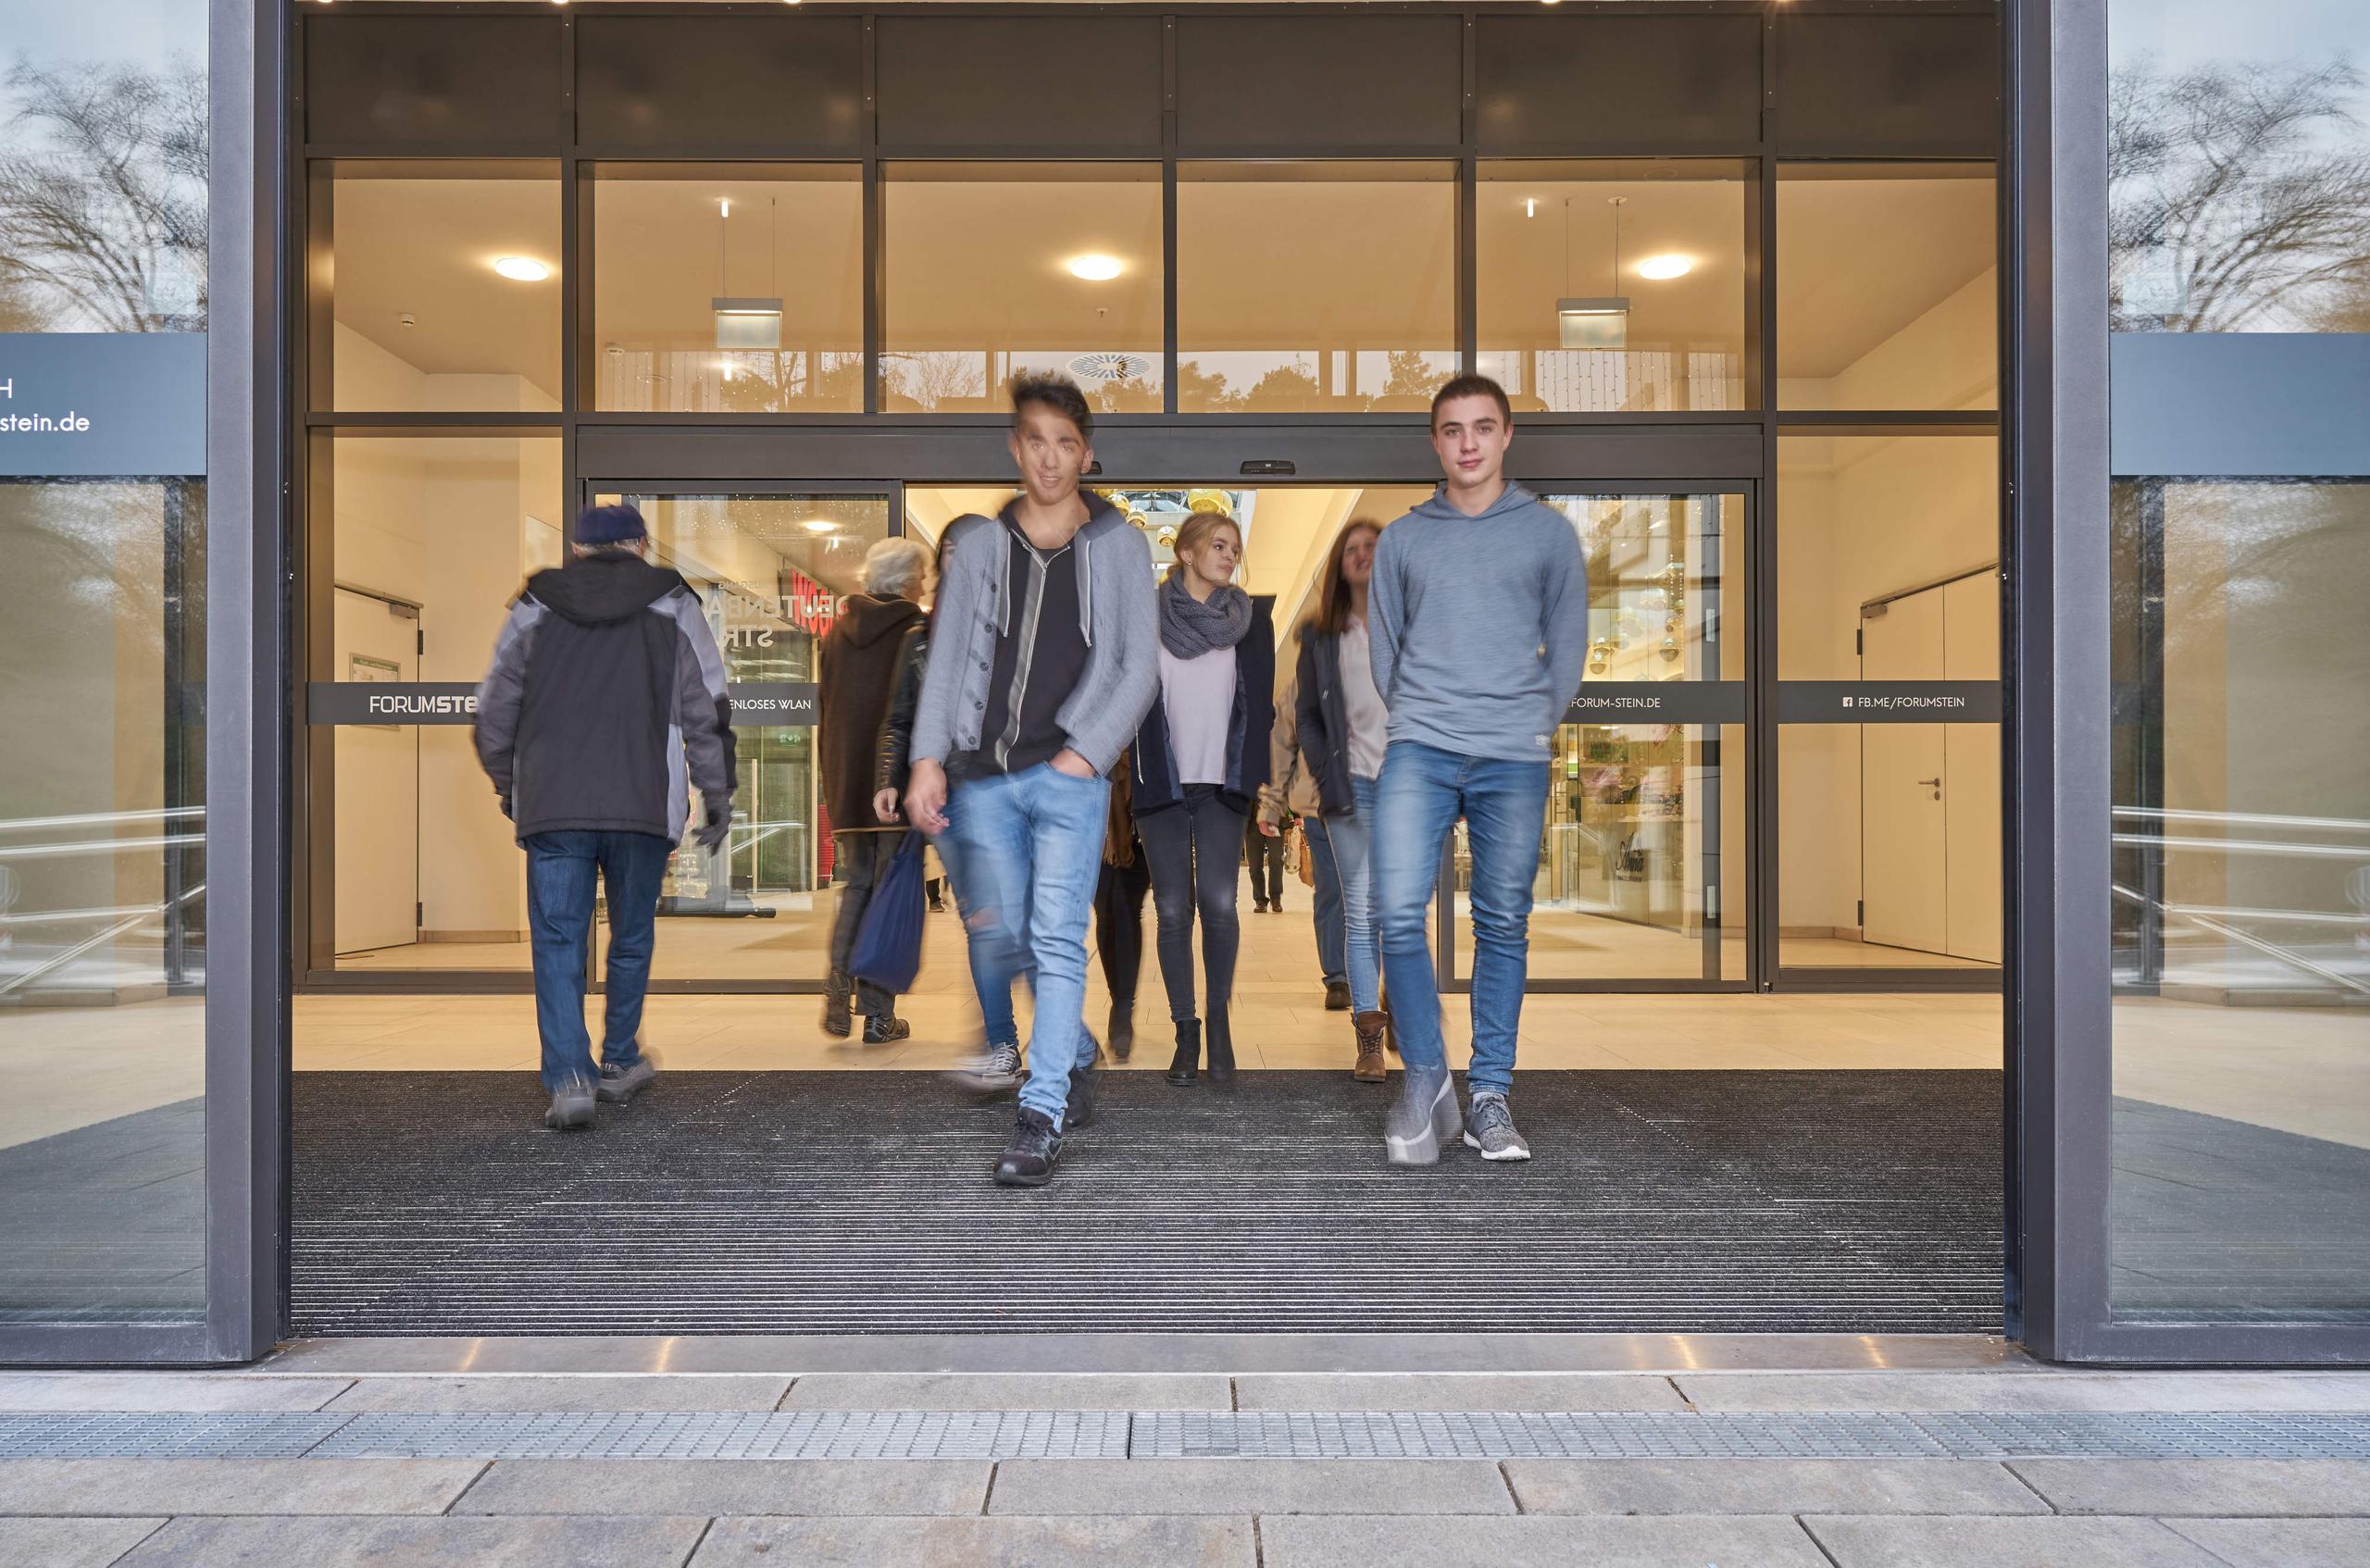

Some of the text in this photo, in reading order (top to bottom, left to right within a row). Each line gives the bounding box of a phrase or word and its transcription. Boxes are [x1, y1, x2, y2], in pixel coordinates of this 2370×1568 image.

[0, 410, 90, 432] stein.de
[779, 699, 811, 710] WLAN
[1858, 696, 1965, 711] FB.ME/FORUMSTEIN
